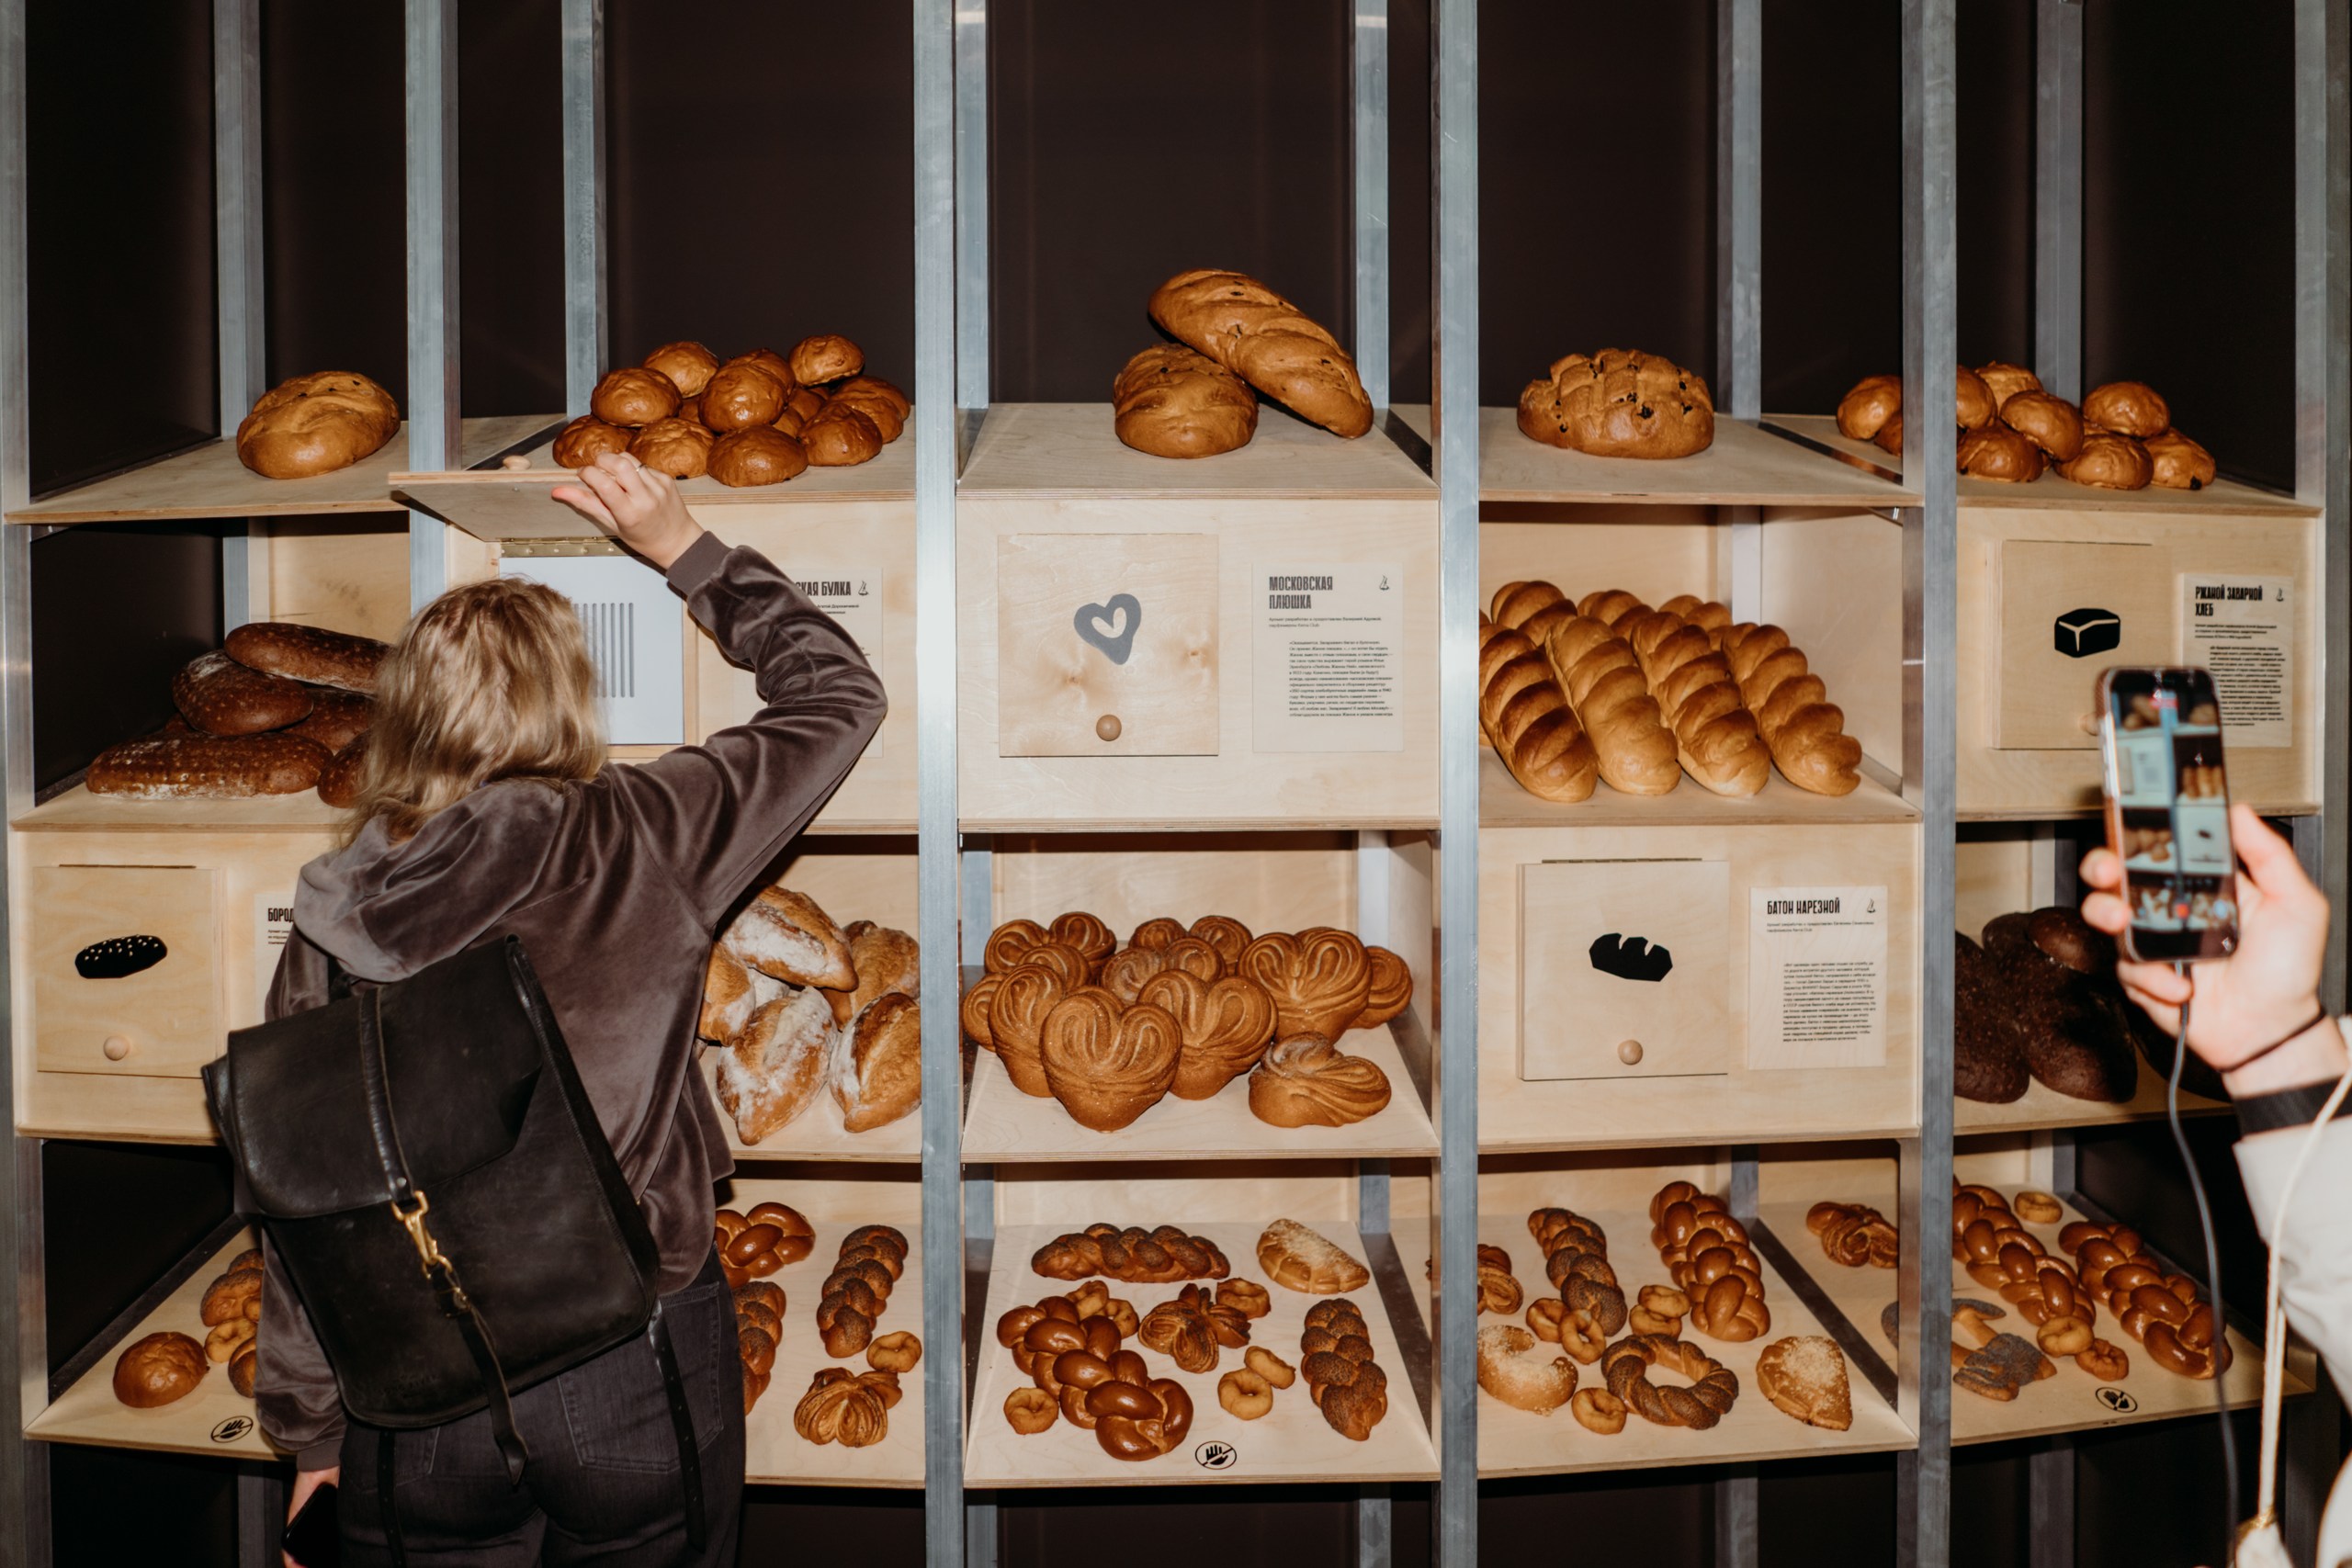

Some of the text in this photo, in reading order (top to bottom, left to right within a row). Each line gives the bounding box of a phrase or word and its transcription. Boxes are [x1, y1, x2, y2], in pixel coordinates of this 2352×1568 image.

[821, 581, 851, 596] БУЛКА
[1269, 576, 1333, 591] МОСКОВСКАЯ
[2195, 584, 2263, 601] РЖАНОЙ ЗАВАРНОЙ
[1269, 594, 1312, 609] ПЛЮШКА
[2195, 603, 2213, 616] ХЛЕБ
[1767, 897, 1840, 915] БАТОН НАРЕЗНОЙ
[267, 908, 294, 922] БОРОД
